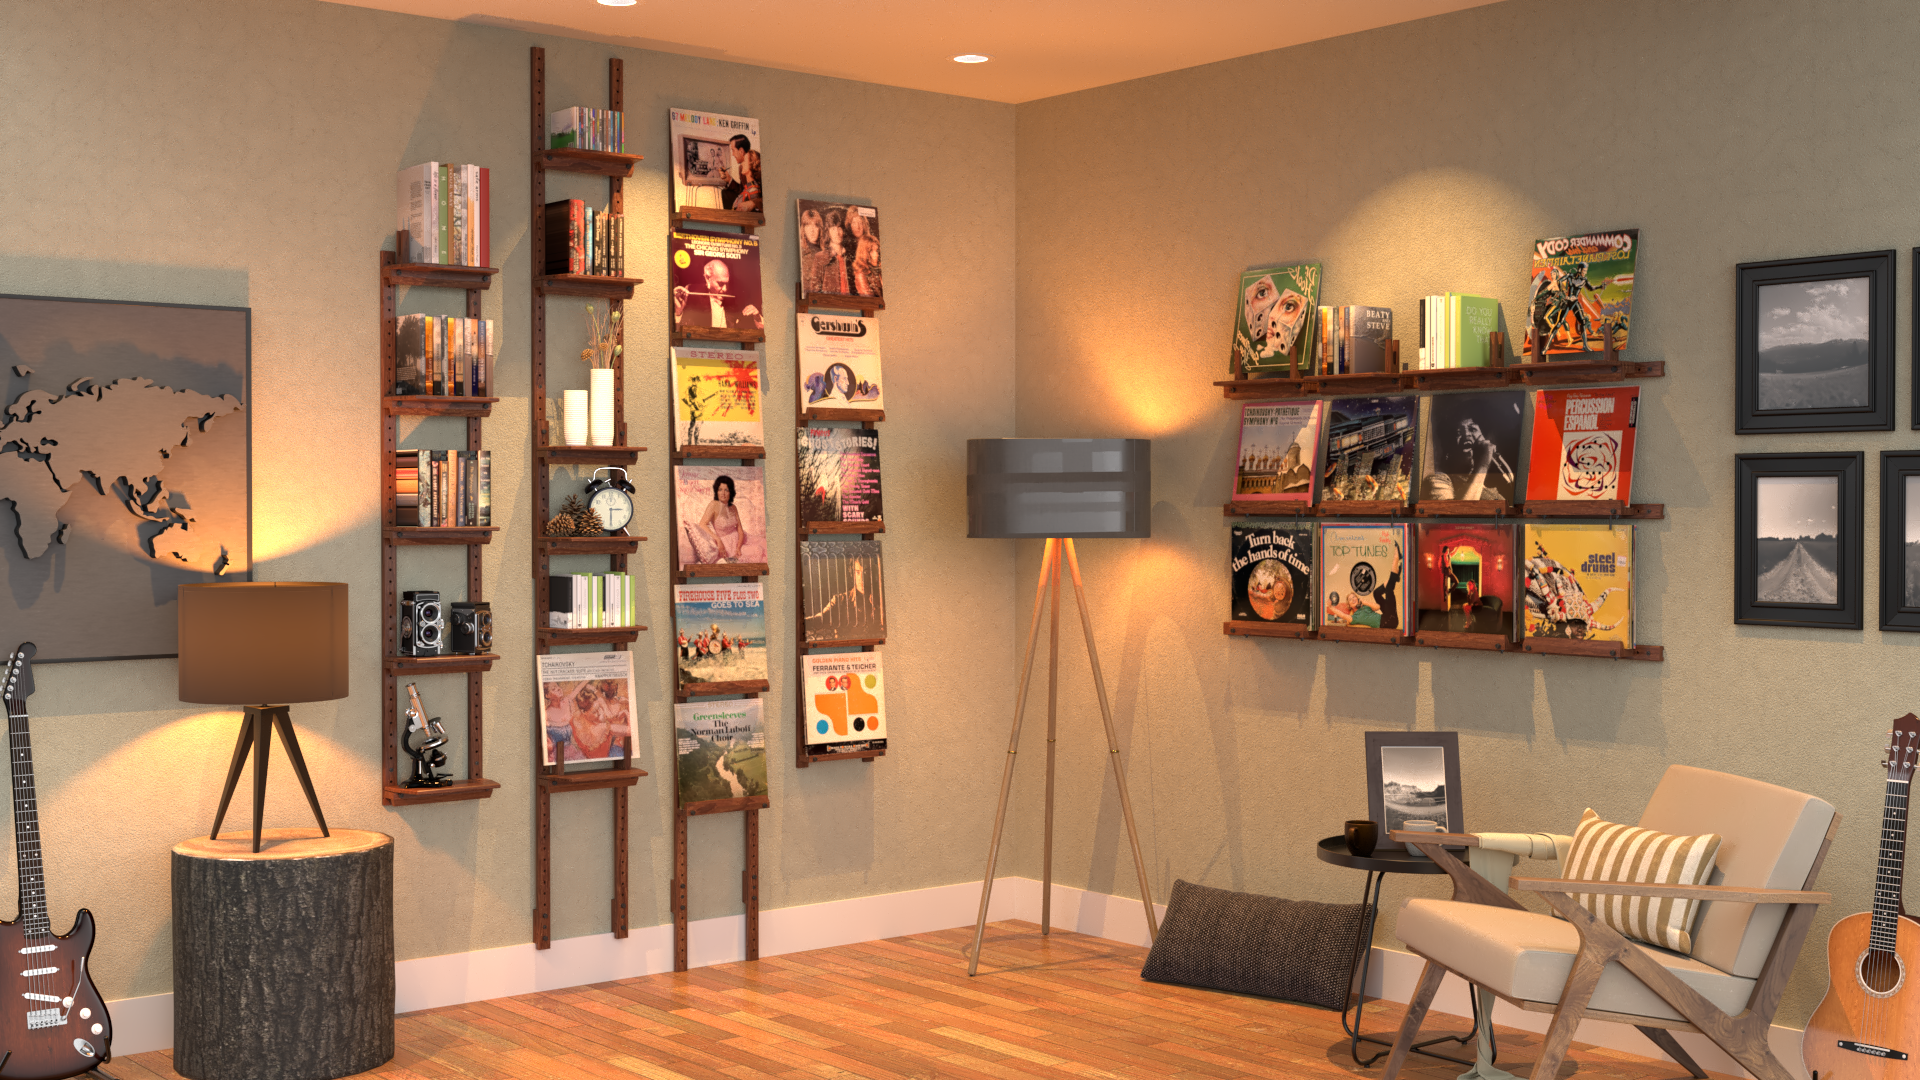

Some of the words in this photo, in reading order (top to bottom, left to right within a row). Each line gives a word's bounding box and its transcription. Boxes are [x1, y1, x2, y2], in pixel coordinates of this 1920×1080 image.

[679, 113, 701, 124] MELODY
[718, 119, 729, 128] KEN
[730, 120, 750, 130] GRIFFIN
[710, 236, 743, 245] SYMPHONY
[720, 246, 749, 254] SYMPHONY
[1366, 310, 1390, 318] BEATY
[1466, 306, 1476, 315] DO
[1479, 308, 1492, 316] YOU
[1470, 316, 1492, 325] REALLY
[1366, 322, 1390, 330] STEVE
[1476, 335, 1489, 343] THA
[691, 351, 743, 360] STEREO
[1566, 397, 1615, 414] PERCUSSION
[801, 436, 833, 449] GHOST
[1245, 532, 1271, 548] Turn
[1272, 530, 1296, 550] back
[1330, 546, 1351, 556] TOP
[1351, 545, 1388, 558] TUNES
[1232, 556, 1248, 572] the
[1247, 544, 1278, 564] hands
[1278, 549, 1291, 561] of
[1288, 553, 1310, 575] time
[1588, 552, 1615, 564] steel
[1581, 561, 1615, 573] drums
[679, 590, 714, 601] FIREHOUSE
[716, 590, 731, 600] FIVE
[733, 591, 746, 600] PLUS
[747, 590, 759, 599] TWO
[693, 712, 746, 721] Greensleeves
[725, 725, 751, 733] Luboff
